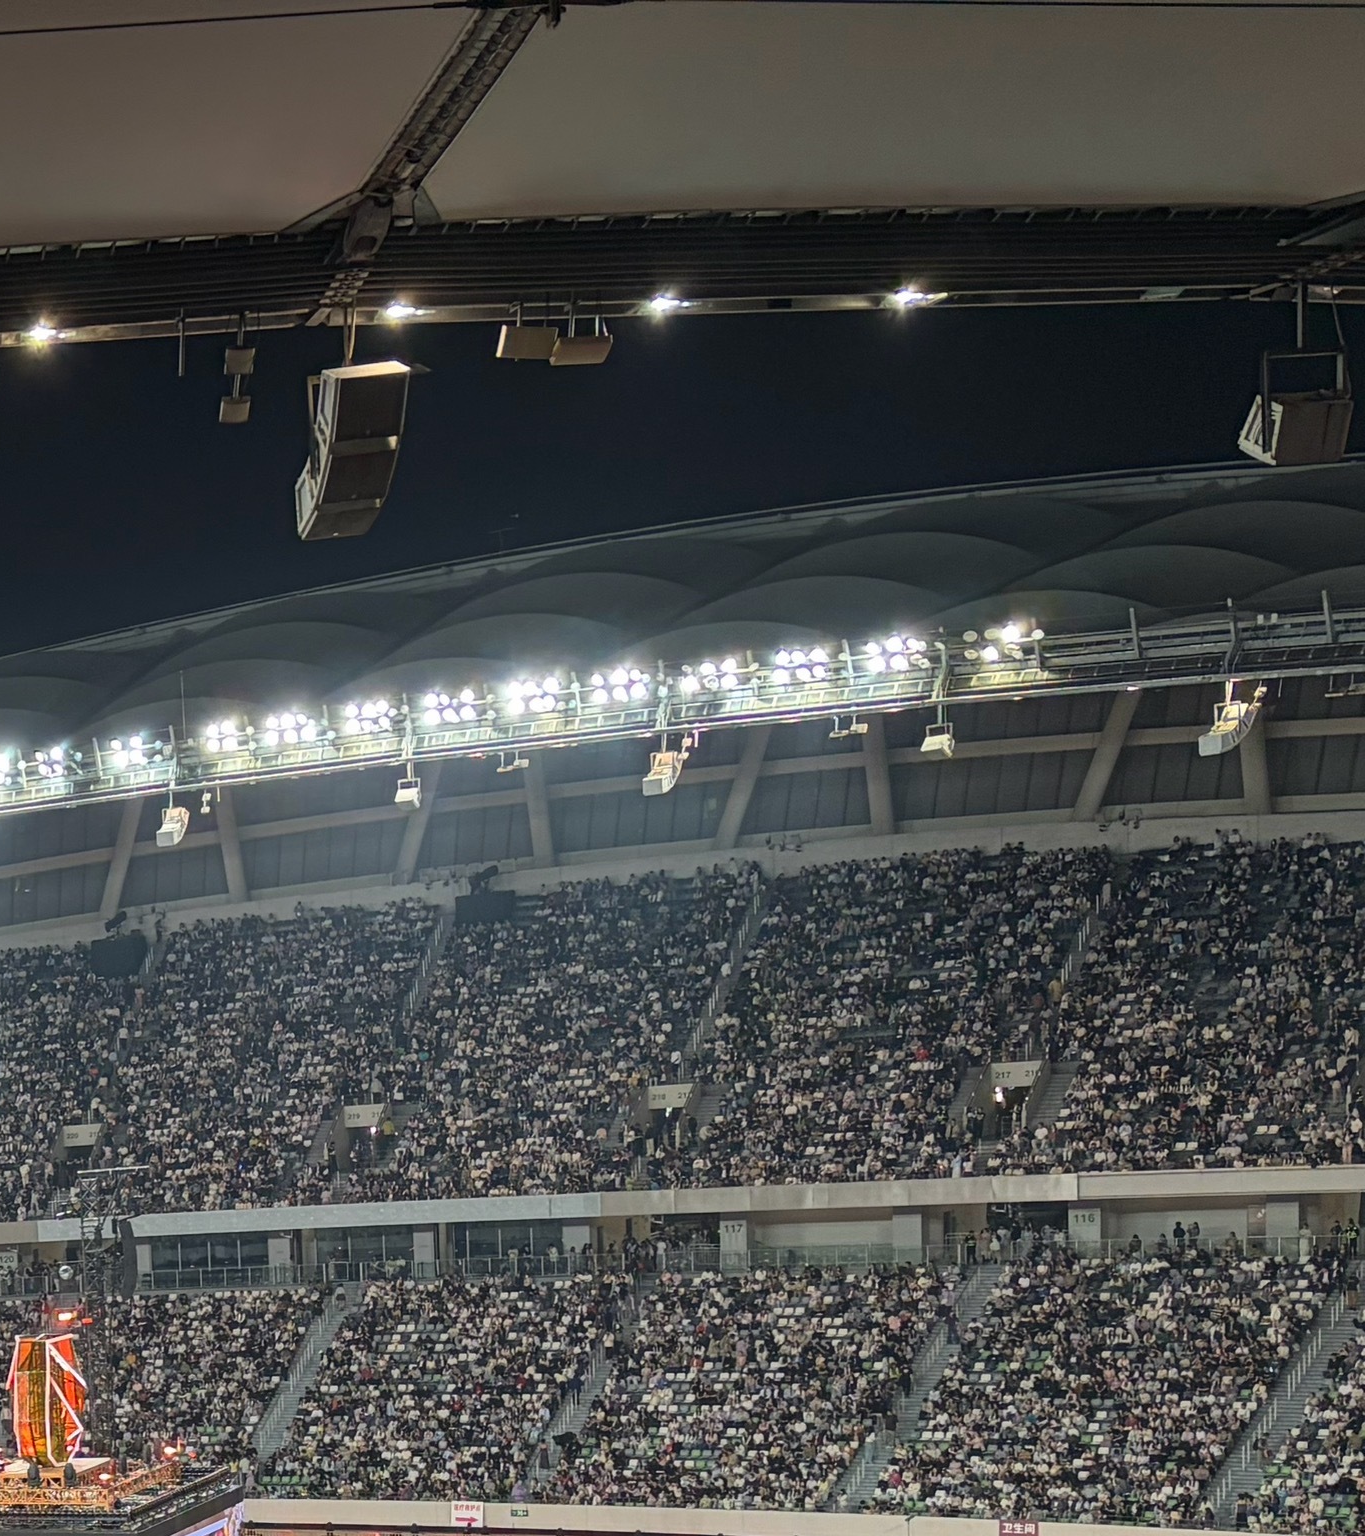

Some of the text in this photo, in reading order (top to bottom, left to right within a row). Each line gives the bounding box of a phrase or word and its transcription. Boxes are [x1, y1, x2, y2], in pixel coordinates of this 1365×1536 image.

[1073, 1213, 1095, 1223] 116
[724, 1223, 743, 1233] 117
[0, 1255, 14, 1264] 120
